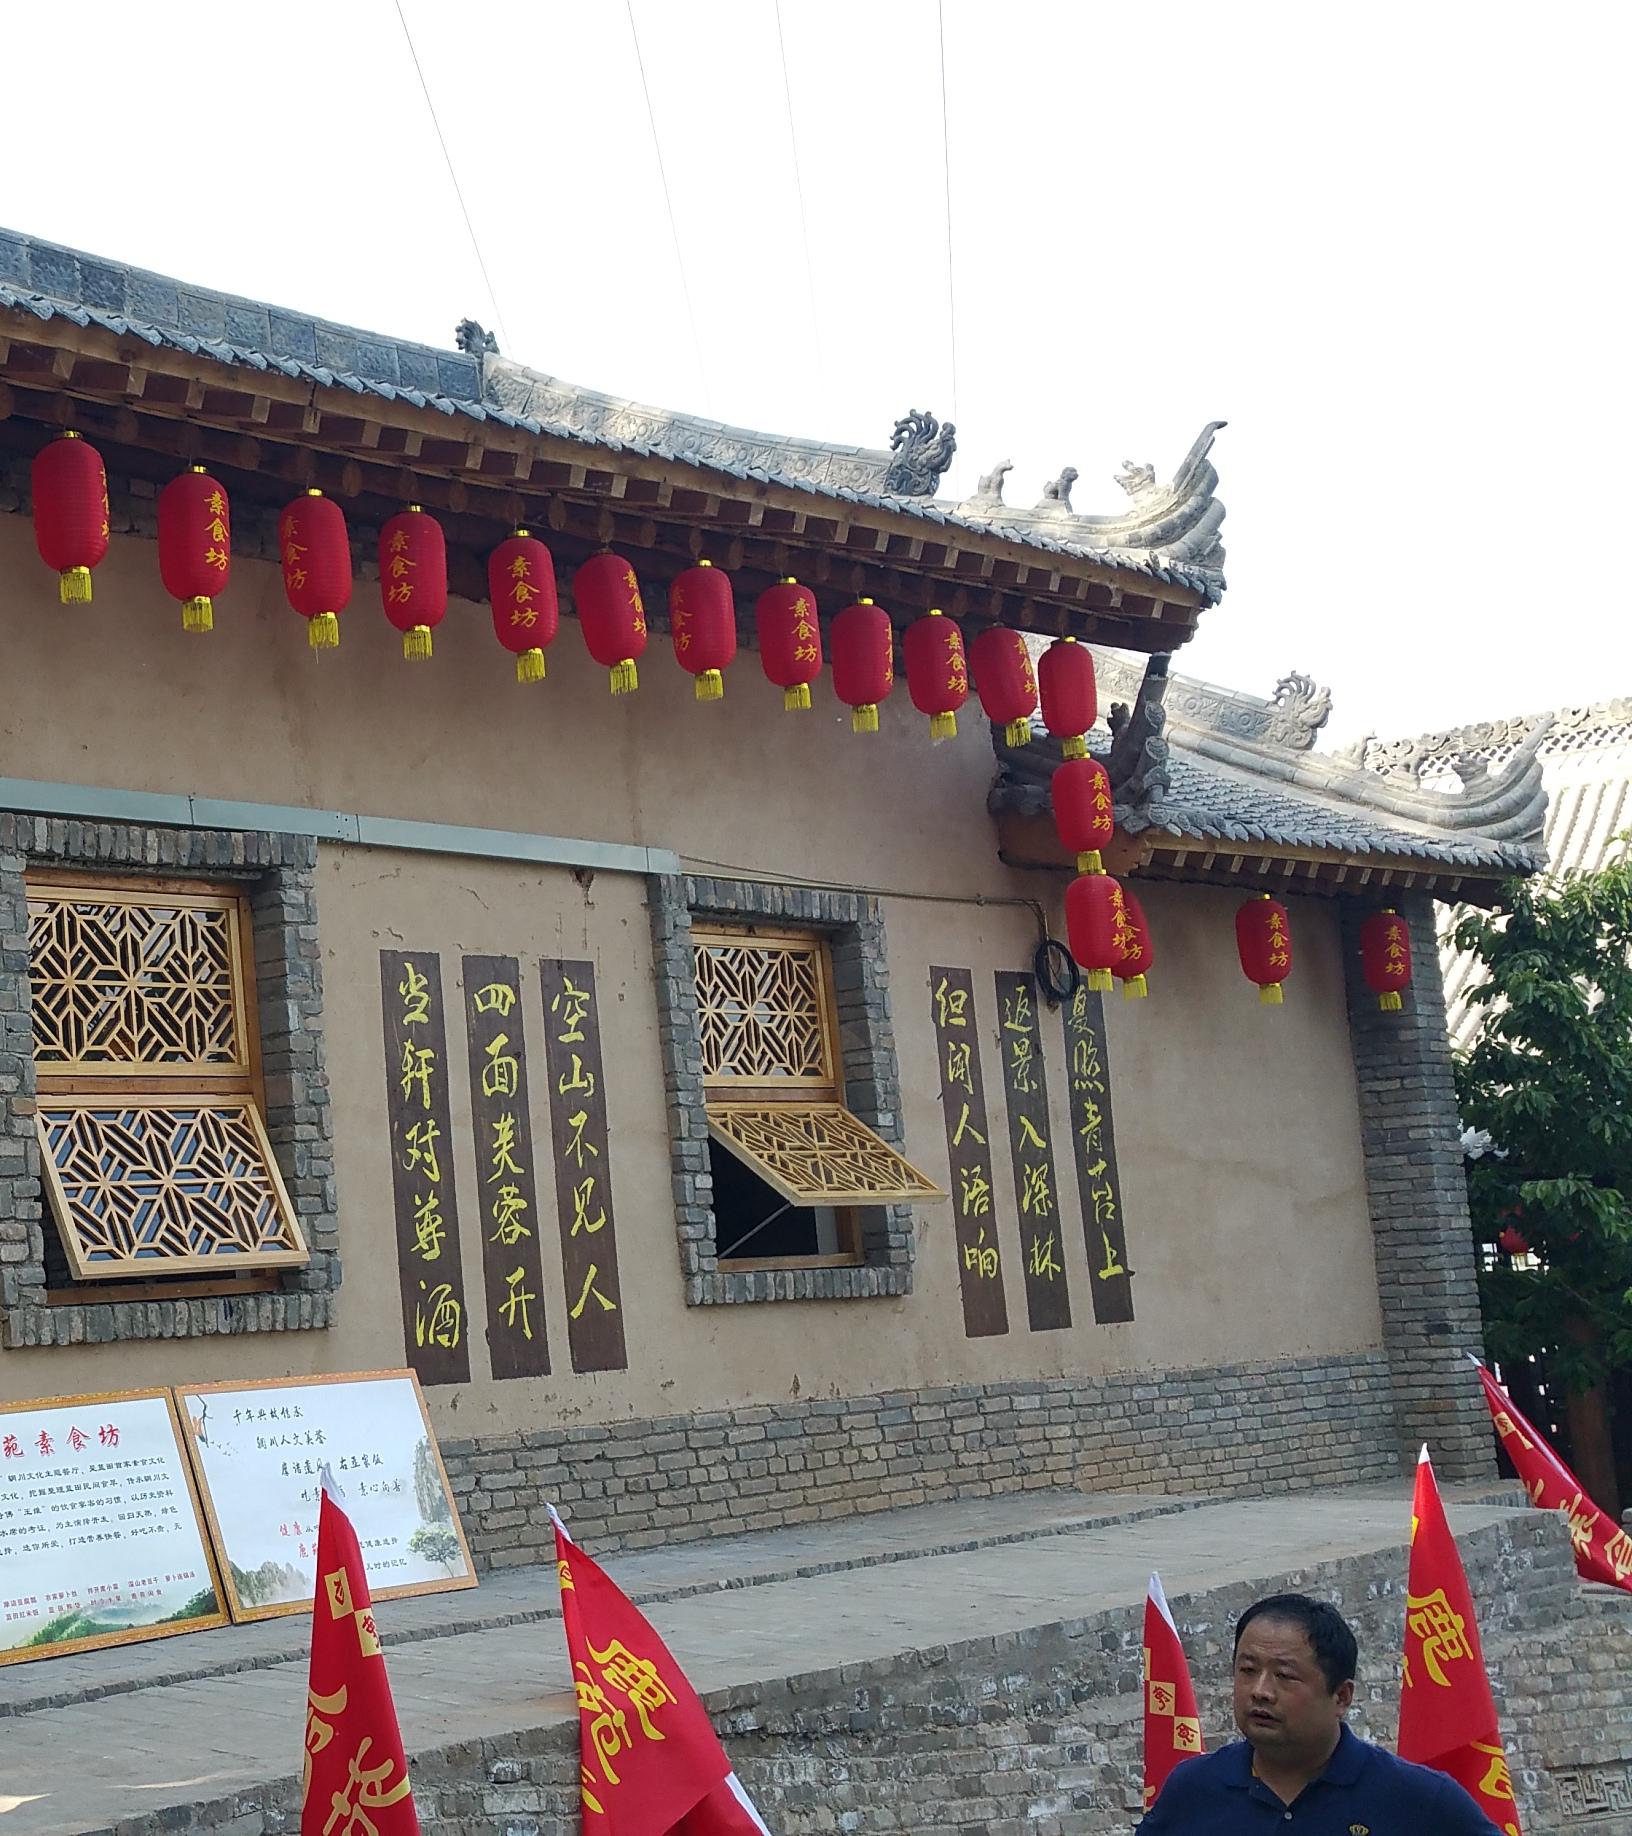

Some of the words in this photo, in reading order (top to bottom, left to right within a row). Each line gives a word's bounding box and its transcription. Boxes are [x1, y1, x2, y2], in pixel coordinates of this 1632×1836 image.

[204, 491, 229, 571] 素食坊
[387, 530, 416, 603] 素食坊
[507, 555, 540, 629] 素食坊
[789, 597, 818, 663] 素食坊
[945, 631, 967, 694] 素食坊
[1088, 771, 1112, 831] 素食坊
[1266, 912, 1289, 967] 素食坊
[1385, 925, 1406, 976] 素食坊
[551, 977, 616, 1320] 空山不见人
